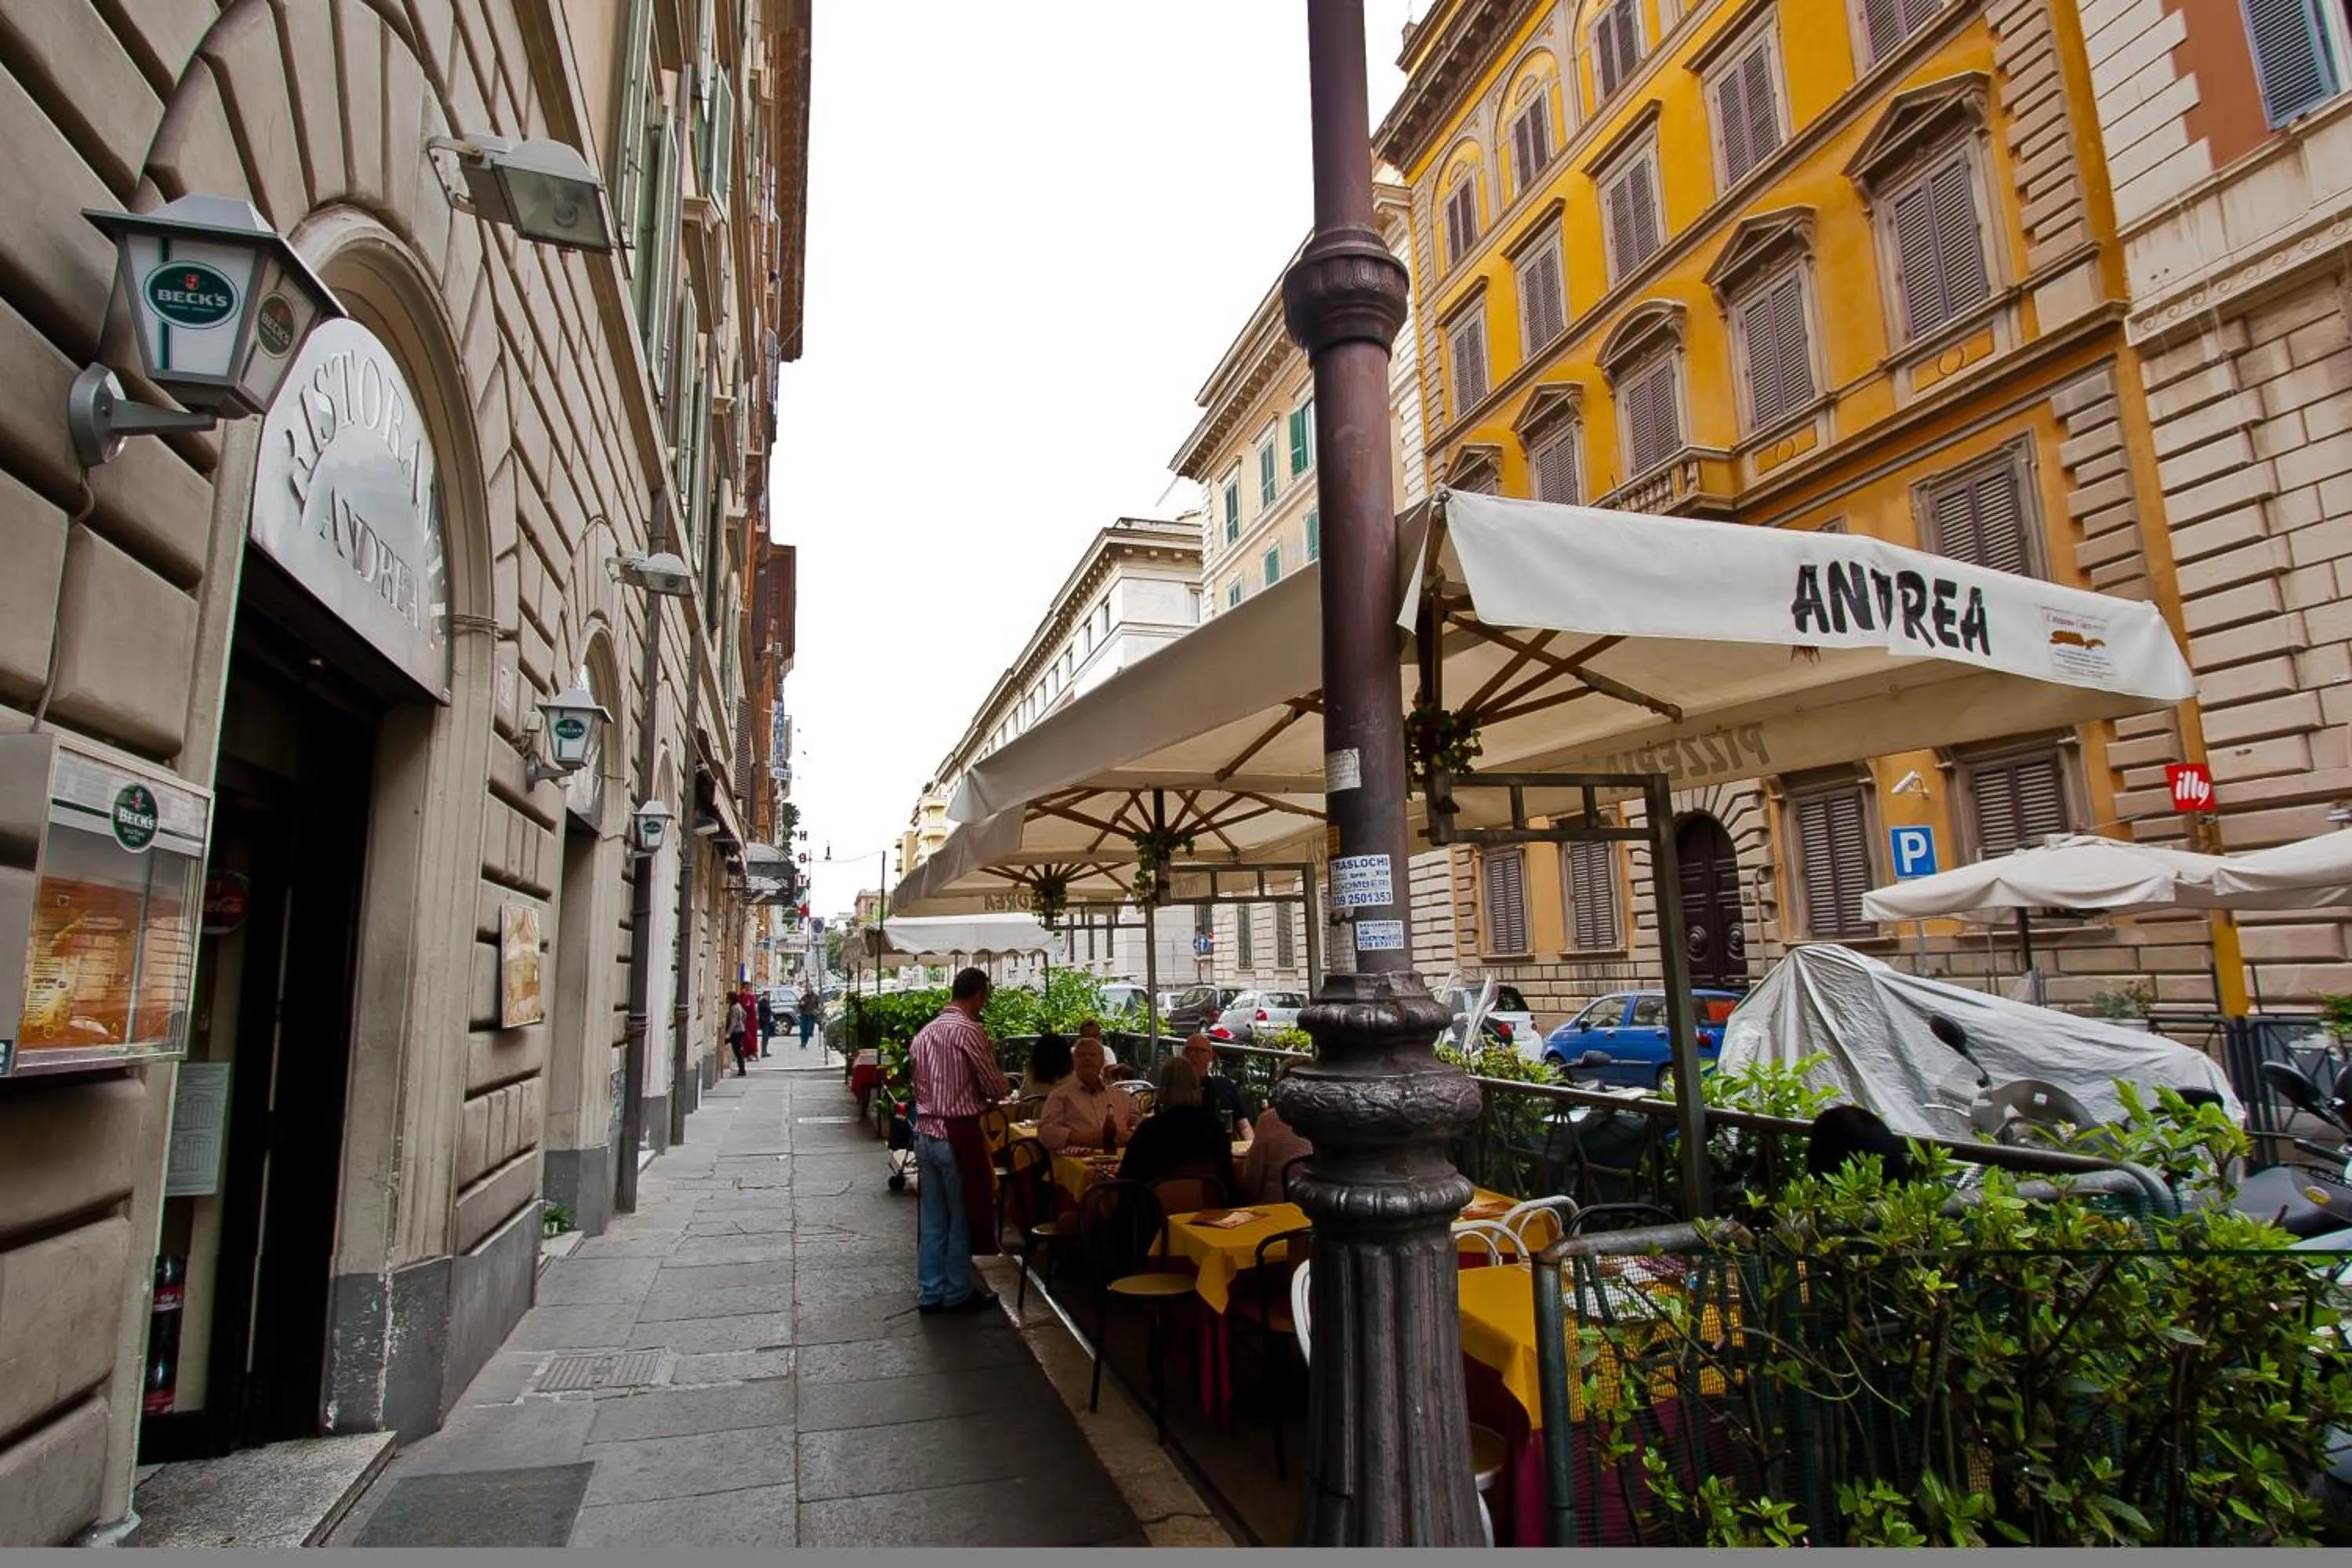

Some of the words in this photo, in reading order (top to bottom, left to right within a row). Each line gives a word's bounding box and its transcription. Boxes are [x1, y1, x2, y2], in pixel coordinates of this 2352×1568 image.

[157, 289, 227, 307] BECK'S
[1791, 561, 1991, 656] ANDREA
[2176, 771, 2209, 805] illy
[119, 807, 154, 830] BECK'S
[1900, 832, 1928, 873] P
[797, 830, 808, 931] HOTL
[1348, 891, 1392, 905] 2501353
